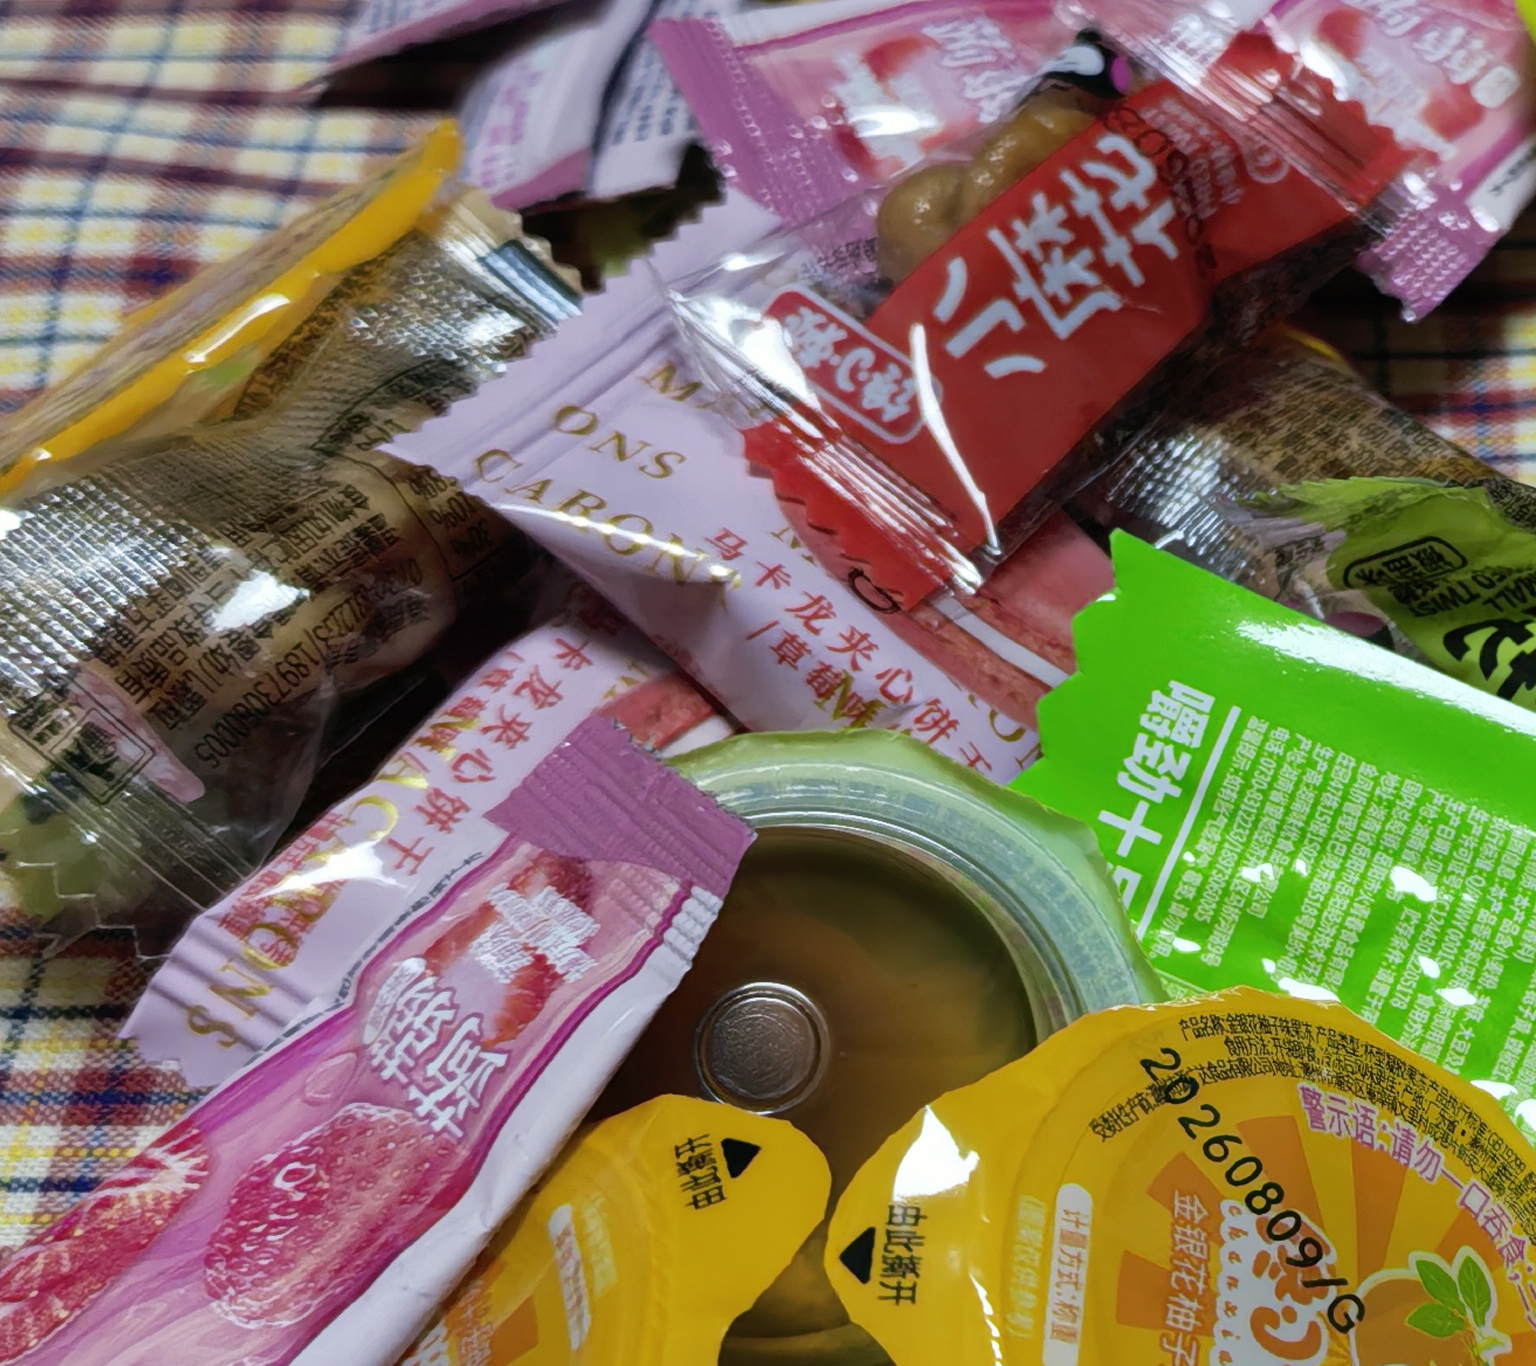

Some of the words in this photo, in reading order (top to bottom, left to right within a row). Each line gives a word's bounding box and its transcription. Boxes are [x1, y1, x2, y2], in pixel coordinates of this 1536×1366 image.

[932, 133, 1180, 380] 小麻花
[553, 404, 688, 482] ONS
[474, 449, 741, 588] CARON
[706, 526, 992, 771] 马卡龙夹心饼干
[1403, 577, 1478, 625] TWIST
[876, 1202, 928, 1308] 由此撕开
[1140, 1045, 1368, 1336] 20260809/G
